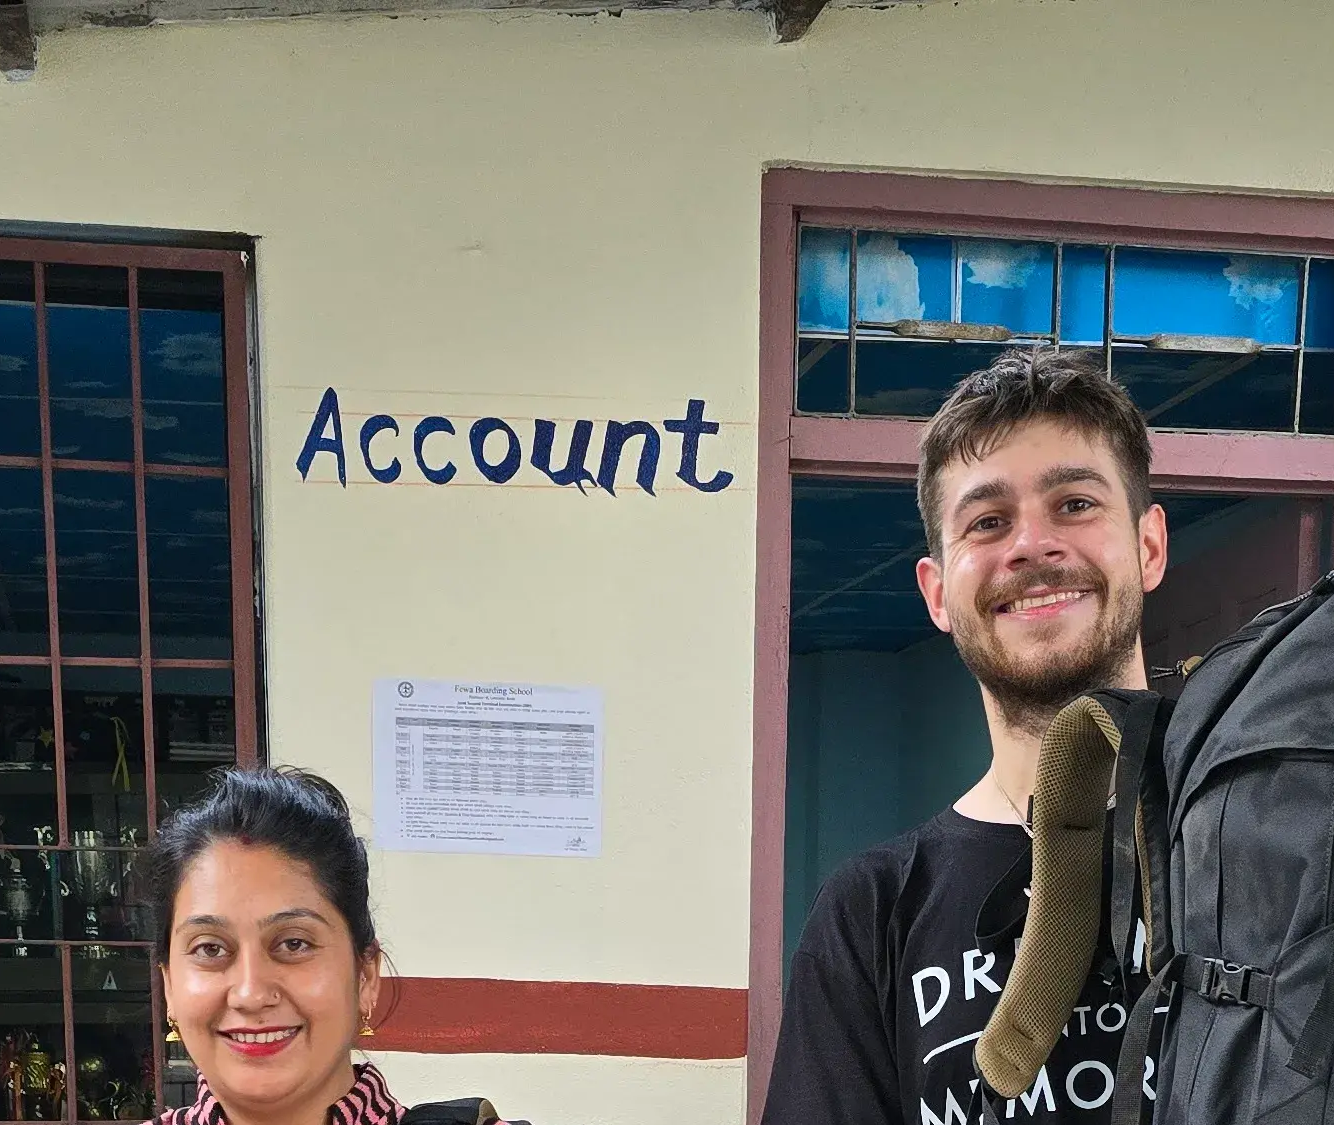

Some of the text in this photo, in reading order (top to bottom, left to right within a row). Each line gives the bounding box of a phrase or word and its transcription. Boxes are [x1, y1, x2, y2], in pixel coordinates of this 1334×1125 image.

[296, 387, 734, 498] Account
[475, 685, 508, 697] Boarding
[509, 687, 533, 696] School
[1061, 1002, 1127, 1036] TO
